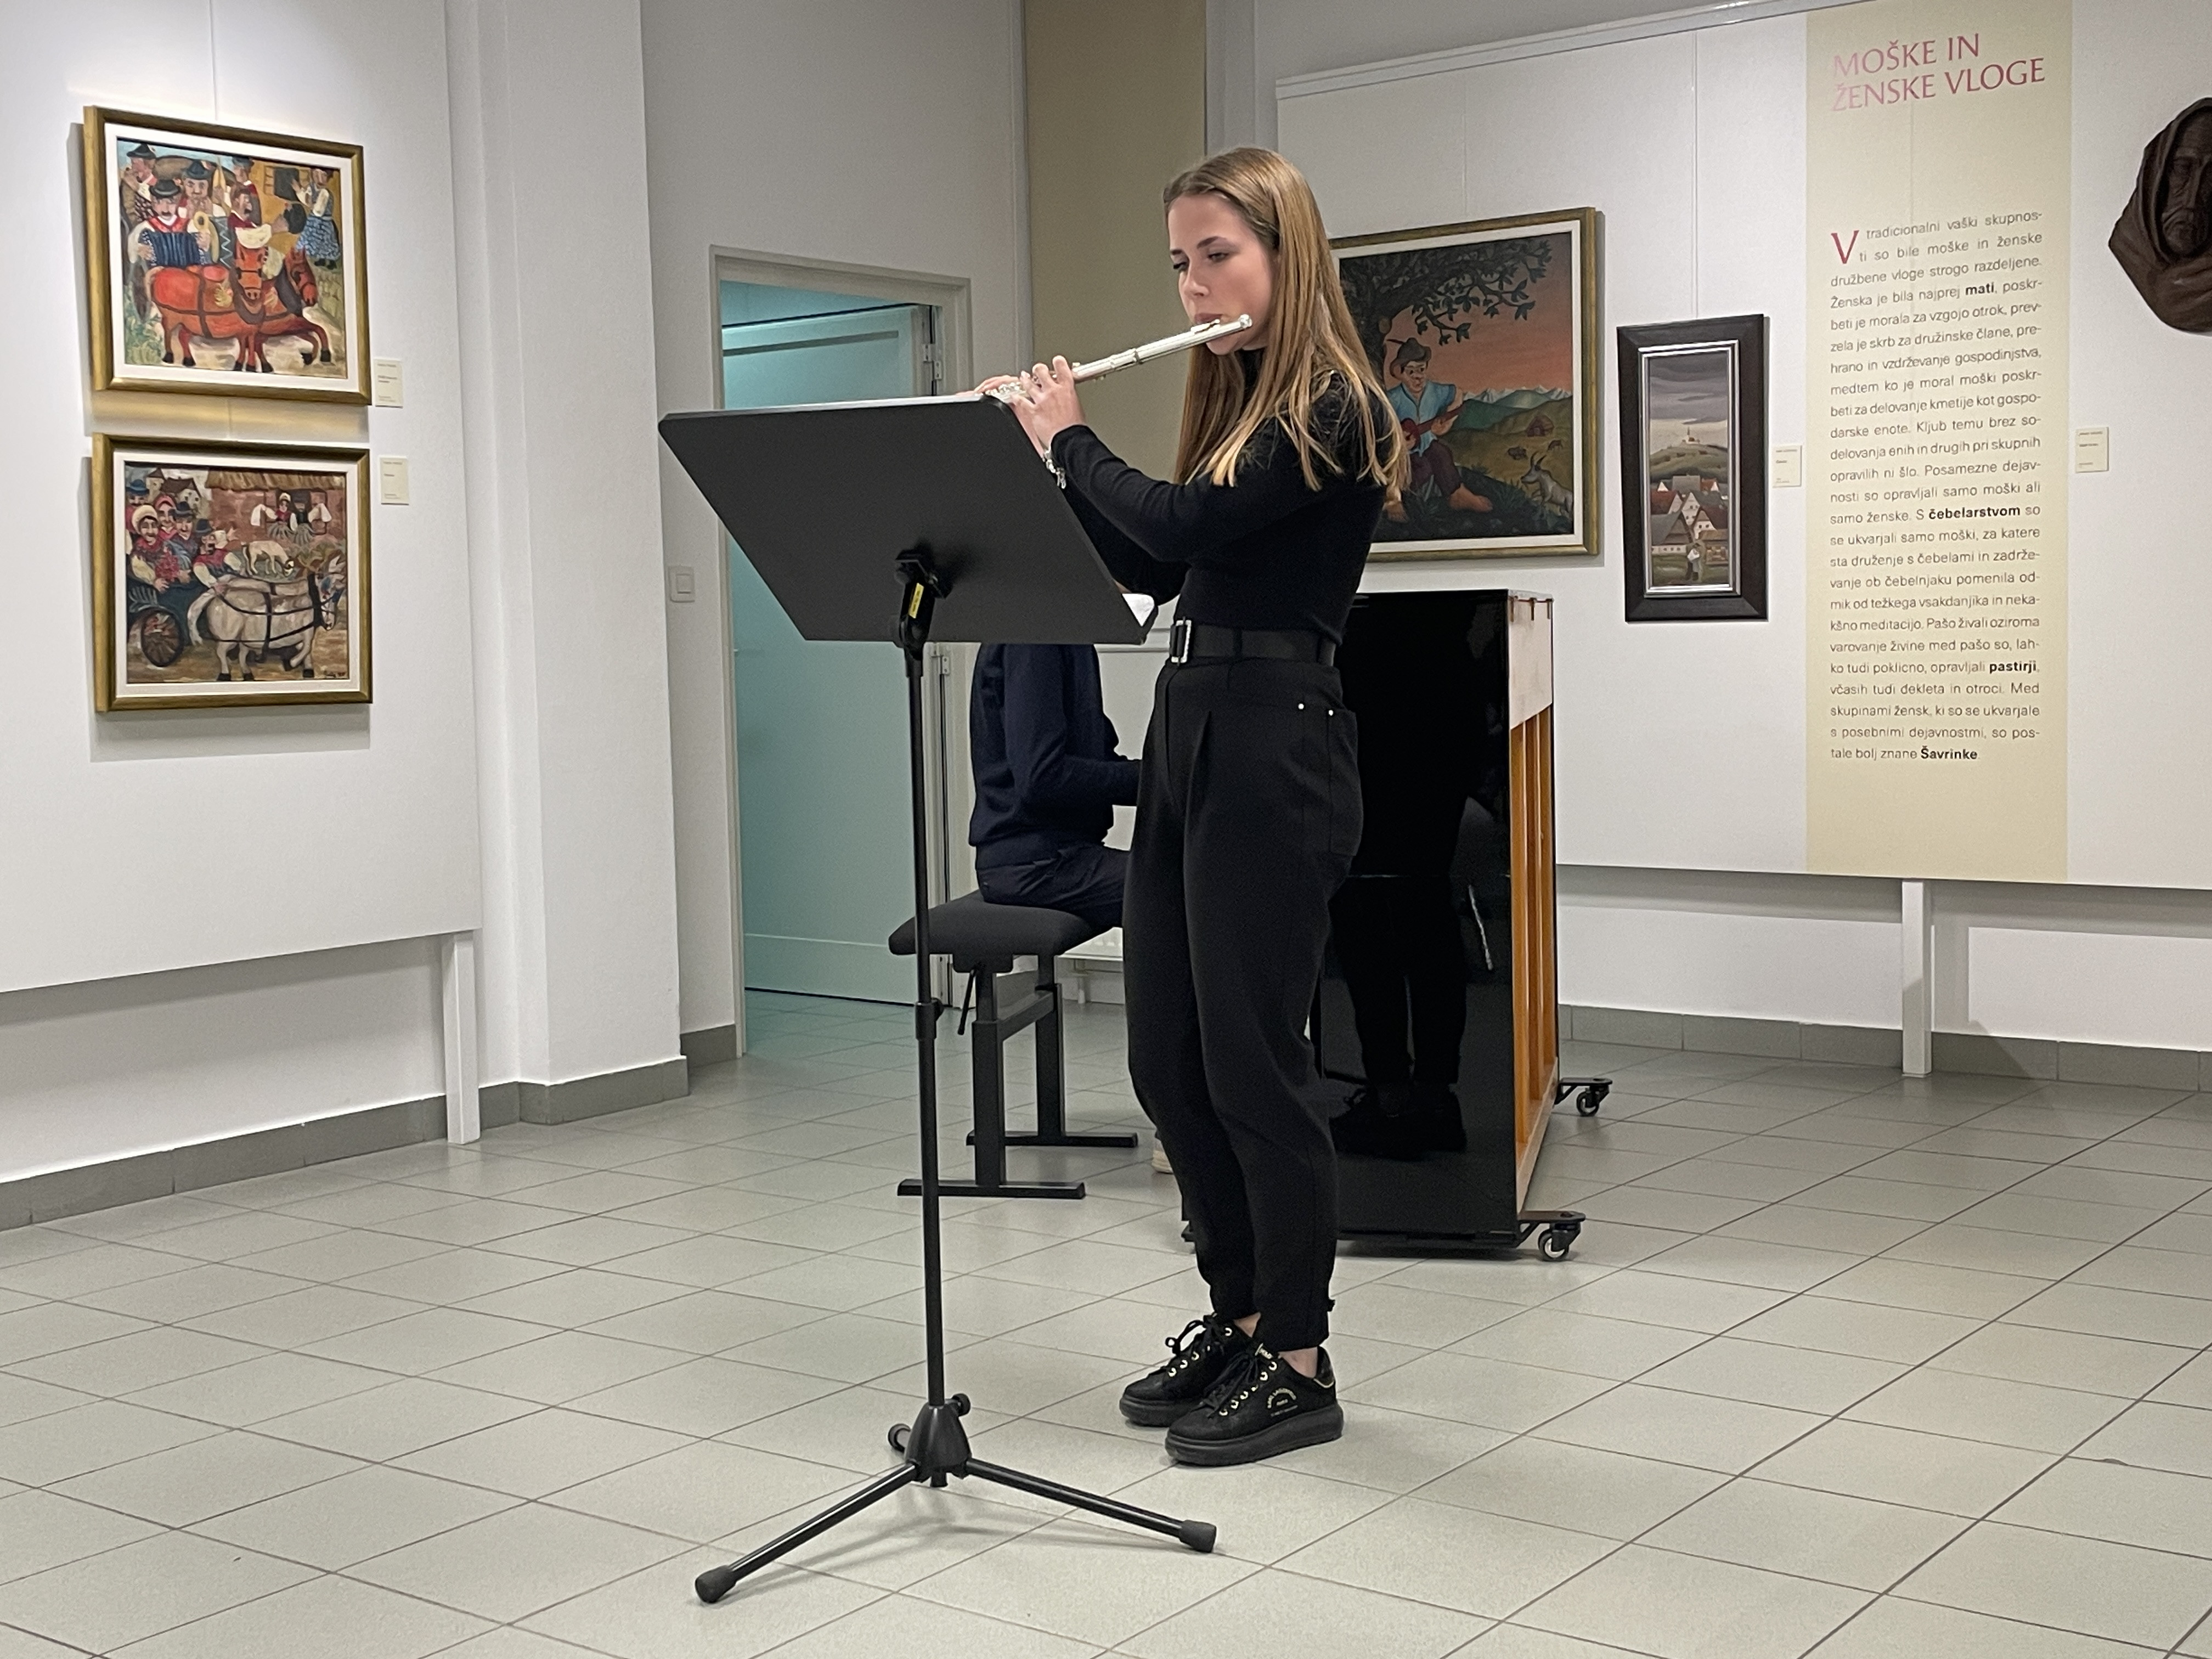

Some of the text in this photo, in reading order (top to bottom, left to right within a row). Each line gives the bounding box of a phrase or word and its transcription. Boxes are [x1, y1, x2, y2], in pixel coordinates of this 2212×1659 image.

[1833, 33, 1978, 77] MOŠKE IN
[1832, 58, 2045, 110] ŽENSKE VLOGE
[1831, 212, 2042, 264] V tradicionalni vaški skupnos-
[1860, 233, 2042, 262] ti so bile moške in ženske
[1831, 274, 1887, 286] družbene
[1892, 269, 1924, 281] vloge
[1930, 265, 1969, 277] strogo
[1831, 296, 1872, 308] Ženska
[1877, 296, 1888, 307] je
[1893, 291, 1913, 302] bila
[1919, 289, 1960, 301] najprej
[2003, 279, 2042, 294] poskr-
[1831, 320, 1852, 330] beti
[1855, 319, 1865, 330] je
[1870, 313, 1910, 326] morala
[1913, 314, 1926, 323] za
[1929, 310, 1970, 323] vzgojo
[2011, 303, 2041, 316] prev-
[1831, 341, 1853, 352] zela
[1857, 340, 1867, 352] je
[1870, 336, 1895, 348] skrb
[1898, 337, 1911, 346] za
[1915, 330, 1973, 345] družinske
[2017, 326, 2041, 338] pre-
[1831, 363, 1863, 373] hrano
[1868, 362, 1877, 370] in
[1882, 356, 1950, 369] vzdrževanje
[1831, 370, 2041, 394] medtem ko je moral moški poskr-
[1831, 394, 2041, 416] beti za delovanje kmetije kot gospo-
[1831, 426, 1869, 438] darske
[1917, 421, 1946, 435] Kljub
[1953, 421, 1983, 430] temu
[1989, 417, 2016, 427] brez
[2022, 416, 2041, 426] so-
[1831, 437, 2040, 460] delovanja enih in drugih pri skupnih
[1831, 469, 1878, 483] opravilih
[1925, 464, 1997, 476] Posamezne
[2002, 460, 2040, 473] dejav-
[1831, 482, 2040, 502] nosti so opravljali samo moški ali
[1831, 515, 1863, 524] samo
[1916, 509, 1924, 520] S
[1929, 507, 2020, 520] čebelarstvom
[2025, 506, 2040, 515] so
[1848, 533, 1896, 546] ukvarjali
[1901, 533, 1934, 543] samo
[1983, 531, 1996, 539] za
[2002, 528, 2040, 538] katere
[1830, 549, 2040, 567] sta druženje s čebelami in zadrže-
[1830, 579, 1861, 590] vanje
[1866, 577, 1881, 587] ob
[1885, 575, 1951, 588] čebelnjaku
[1957, 572, 2015, 586] pomenila
[1831, 599, 1850, 609] mik
[1853, 599, 1868, 609] od
[1871, 598, 1916, 610] težkega
[1919, 595, 1988, 608] vsakdanjika
[2006, 594, 2039, 605] neka-
[1831, 620, 1858, 631] kšno
[1927, 618, 1956, 629] Pašo
[1959, 617, 1988, 628] živali
[1990, 618, 2039, 628] oziroma
[1830, 639, 2039, 653] varovanje živine med pašo so, lah-
[1831, 663, 1843, 673] ko
[1847, 663, 1869, 673] tudi
[1874, 663, 1927, 675] poklicno,
[1931, 661, 1985, 674] opravljali
[1830, 684, 1867, 695] včasih
[1874, 684, 1895, 695] tudi
[1900, 684, 1944, 694] dekleta
[2011, 682, 2039, 693] Med
[1831, 706, 1891, 717] skupinami
[1936, 706, 1944, 715] ki
[1948, 708, 1962, 716] so
[1966, 707, 1979, 716] se
[1984, 706, 2039, 718] ukvarjale
[1842, 727, 1904, 738] posebnimi
[1909, 727, 1986, 740] dejavnostmi,
[1992, 729, 2006, 738] so
[2012, 729, 2039, 740] pos-
[1831, 748, 1852, 758] tale
[1856, 748, 1876, 760] bolj
[1881, 751, 1917, 759] znane
